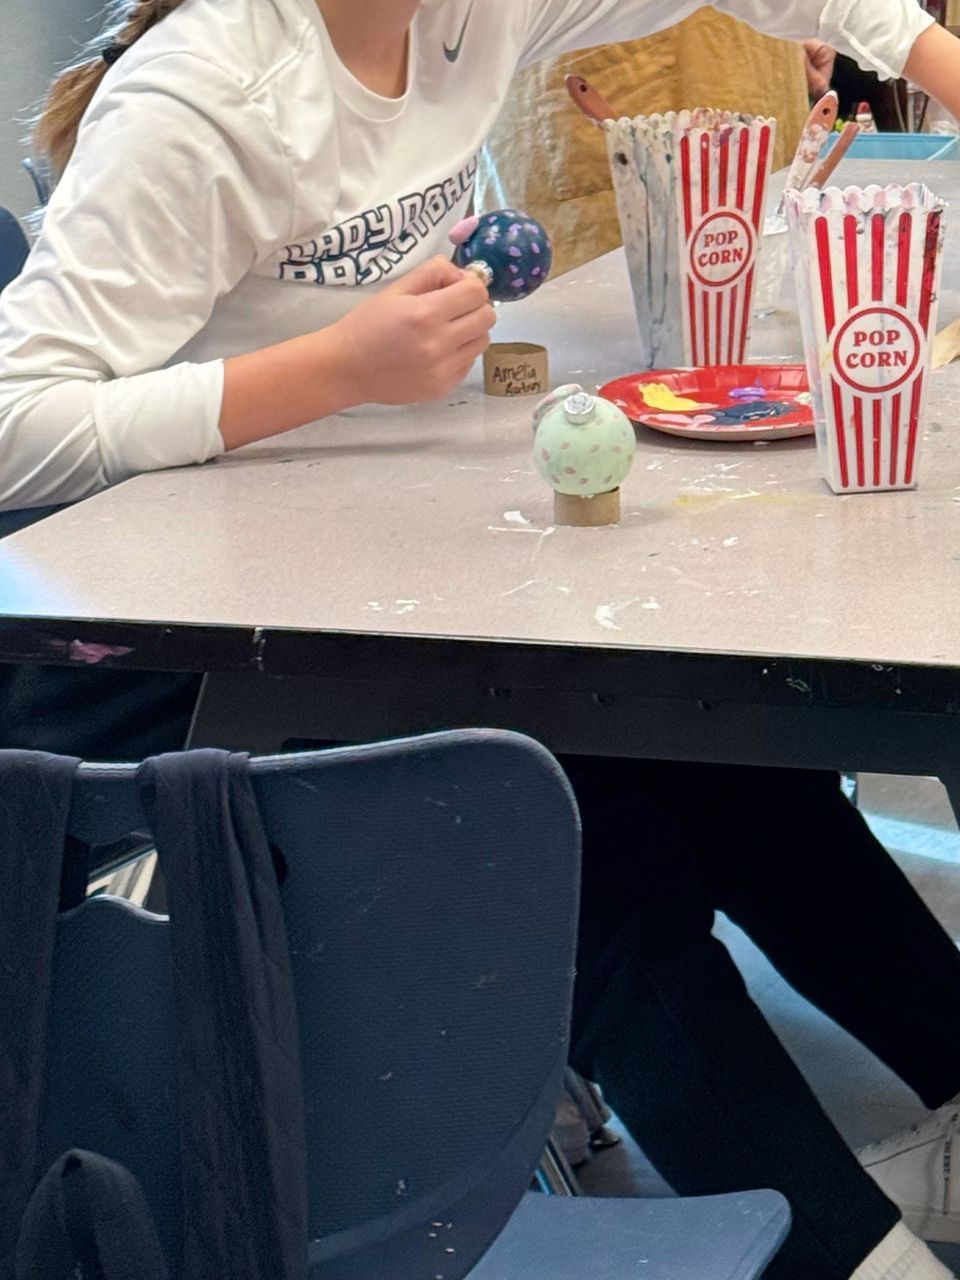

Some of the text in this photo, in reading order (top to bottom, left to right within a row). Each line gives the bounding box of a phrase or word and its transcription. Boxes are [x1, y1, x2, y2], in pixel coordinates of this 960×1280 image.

[286, 204, 395, 265] LADY
[703, 230, 738, 249] POP
[698, 247, 744, 268] CORN
[852, 330, 901, 348] POP
[845, 350, 908, 370] CORN
